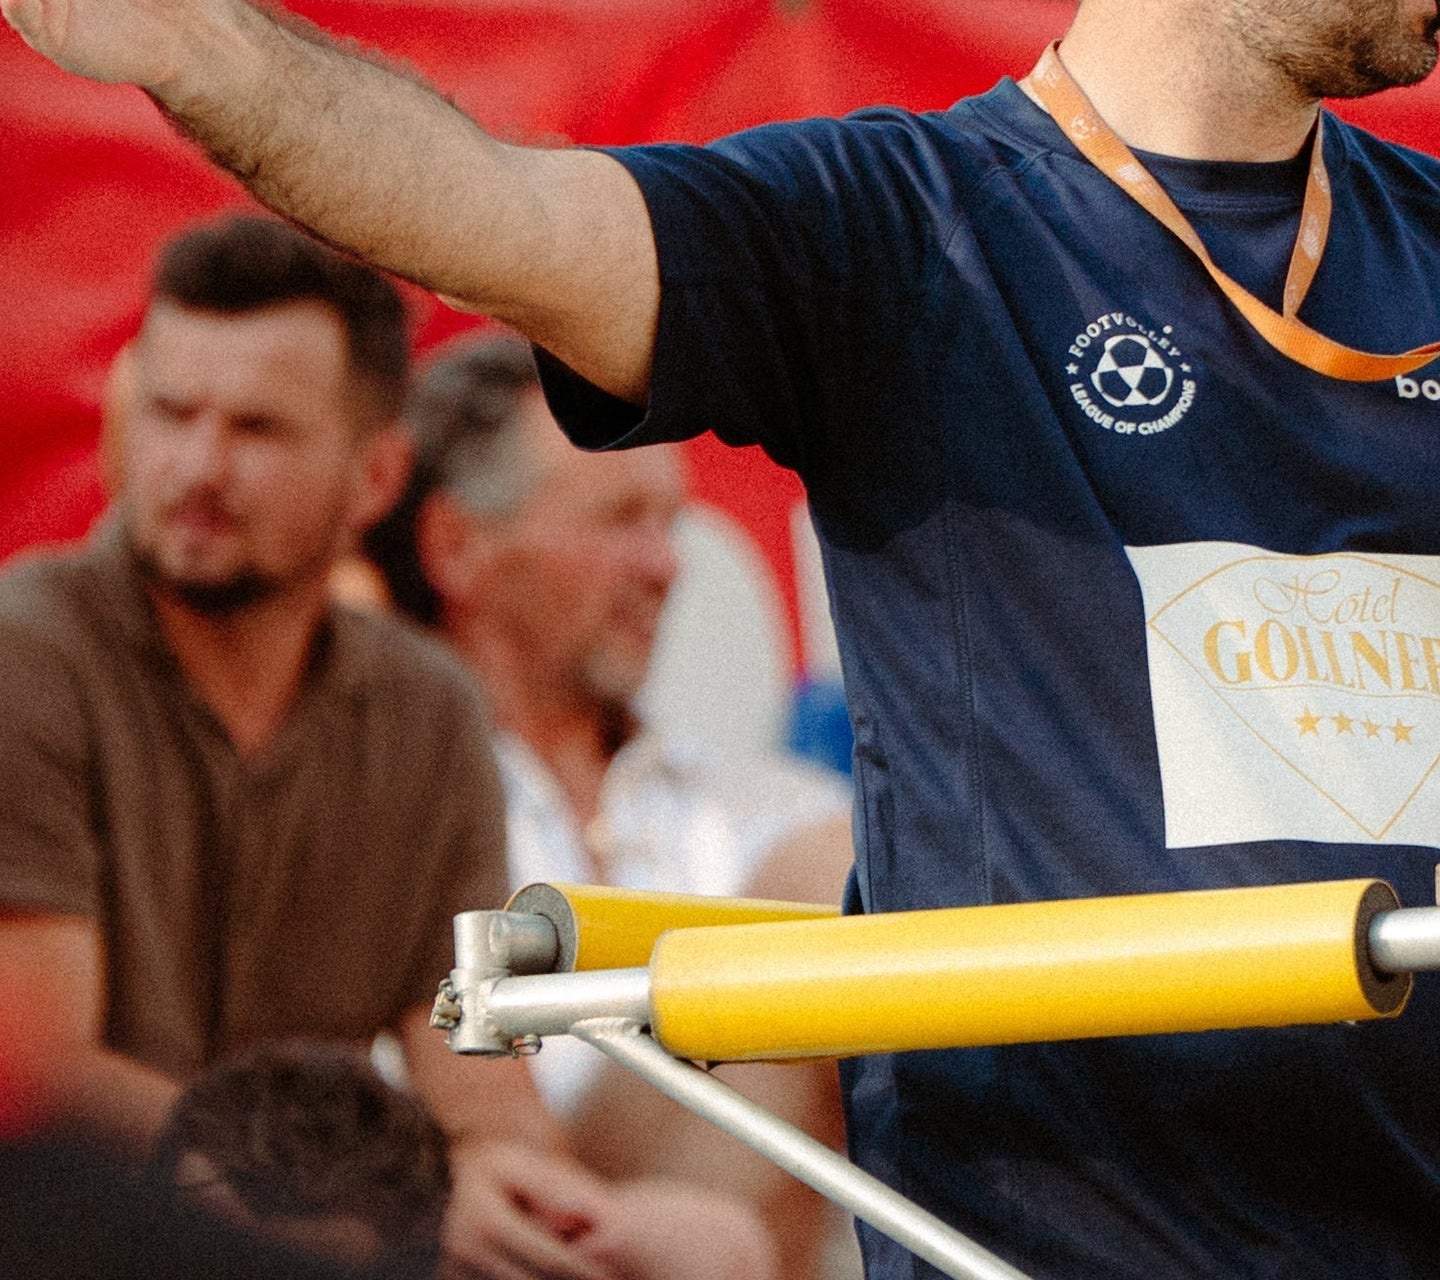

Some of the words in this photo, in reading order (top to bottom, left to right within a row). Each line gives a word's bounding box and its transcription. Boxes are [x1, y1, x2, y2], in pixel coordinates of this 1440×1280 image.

[1068, 312, 1181, 359] FOOTVOLLEY
[1069, 382, 1115, 430] LEAGUE
[1113, 420, 1137, 435] OF
[1137, 378, 1197, 436] CHAMPIONS
